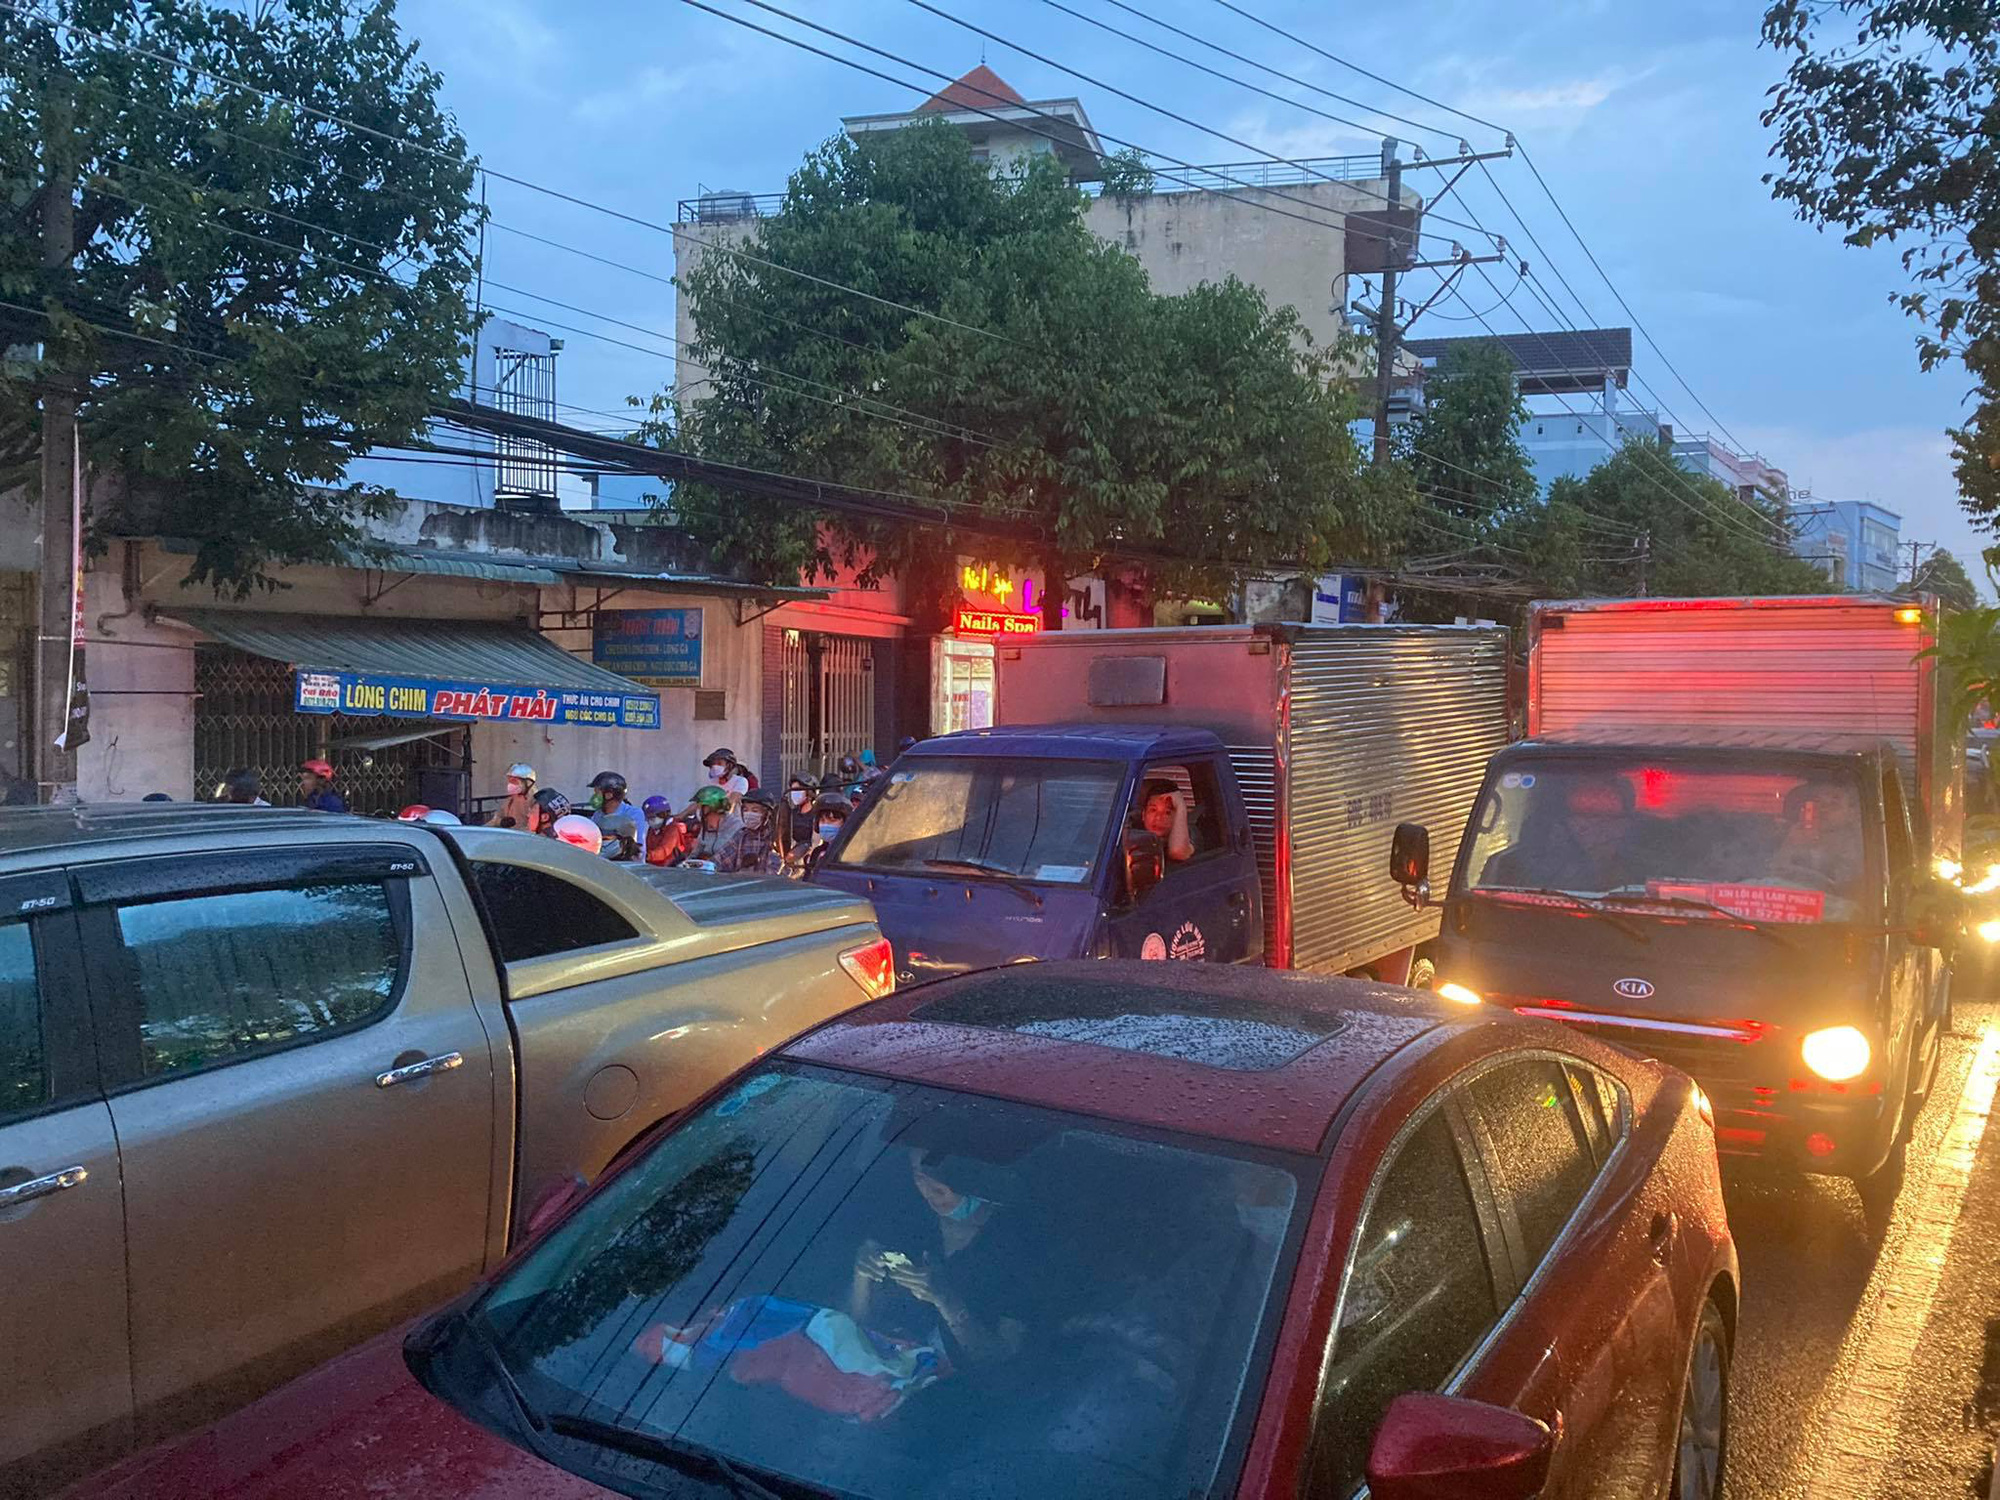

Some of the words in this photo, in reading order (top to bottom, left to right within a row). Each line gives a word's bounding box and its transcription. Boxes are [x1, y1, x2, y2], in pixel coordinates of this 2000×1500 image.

[960, 613, 1000, 631] Nails
[1003, 617, 1035, 634] Spa
[389, 686, 426, 712] CHIM
[432, 687, 509, 716] PHÁT
[508, 690, 558, 719] HẢI
[21, 896, 56, 910] BT-50
[1620, 981, 1648, 994] KIA
